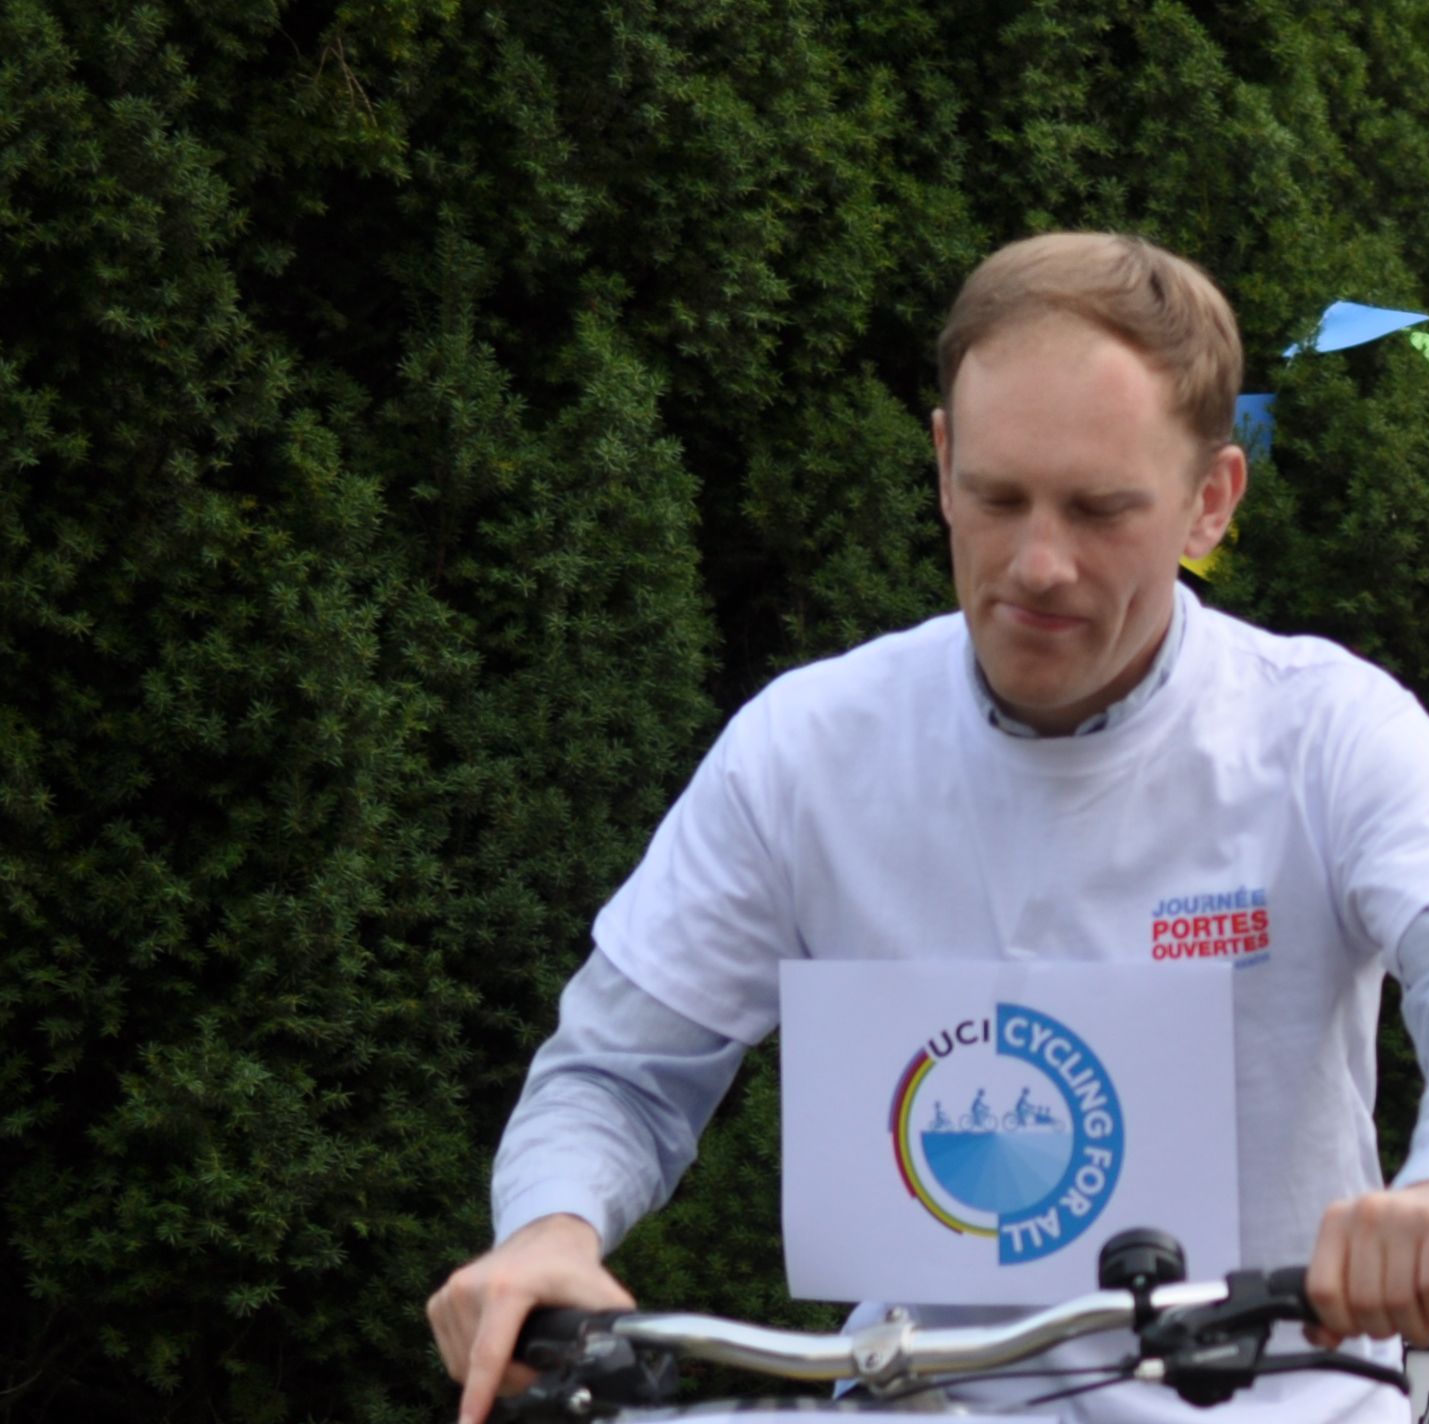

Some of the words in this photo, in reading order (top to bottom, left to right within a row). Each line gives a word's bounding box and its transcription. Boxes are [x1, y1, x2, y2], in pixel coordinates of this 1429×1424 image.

[1152, 886, 1265, 918] JOURNÉE
[1153, 910, 1269, 942] PORTES
[1153, 933, 1269, 961] OUVERTES
[928, 1019, 990, 1058] UCI
[1003, 1016, 1114, 1139] CYCLING
[1059, 1145, 1113, 1217] FOR
[1003, 1206, 1061, 1253] ALL
